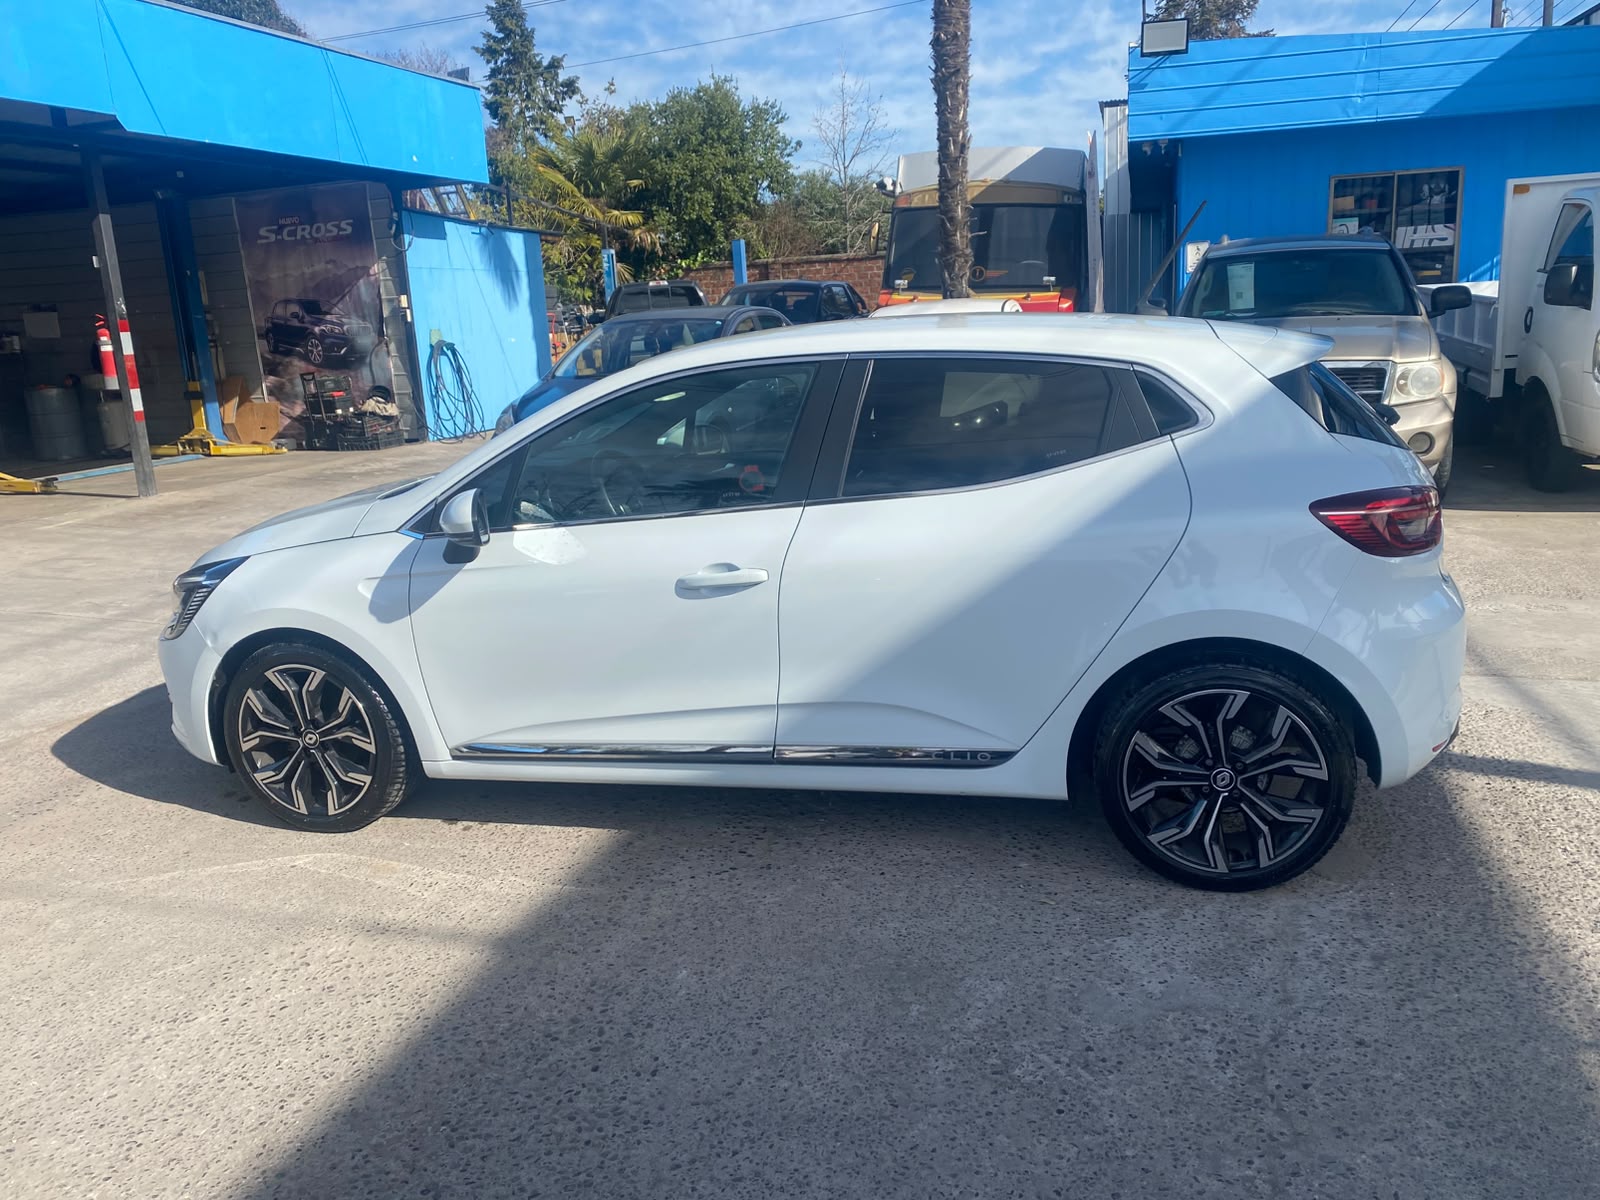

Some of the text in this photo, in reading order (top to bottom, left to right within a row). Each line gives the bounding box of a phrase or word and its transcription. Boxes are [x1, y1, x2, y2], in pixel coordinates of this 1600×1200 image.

[278, 216, 299, 225] NUEVO
[256, 219, 353, 244] S-CROSS
[932, 751, 991, 761] CLIO
